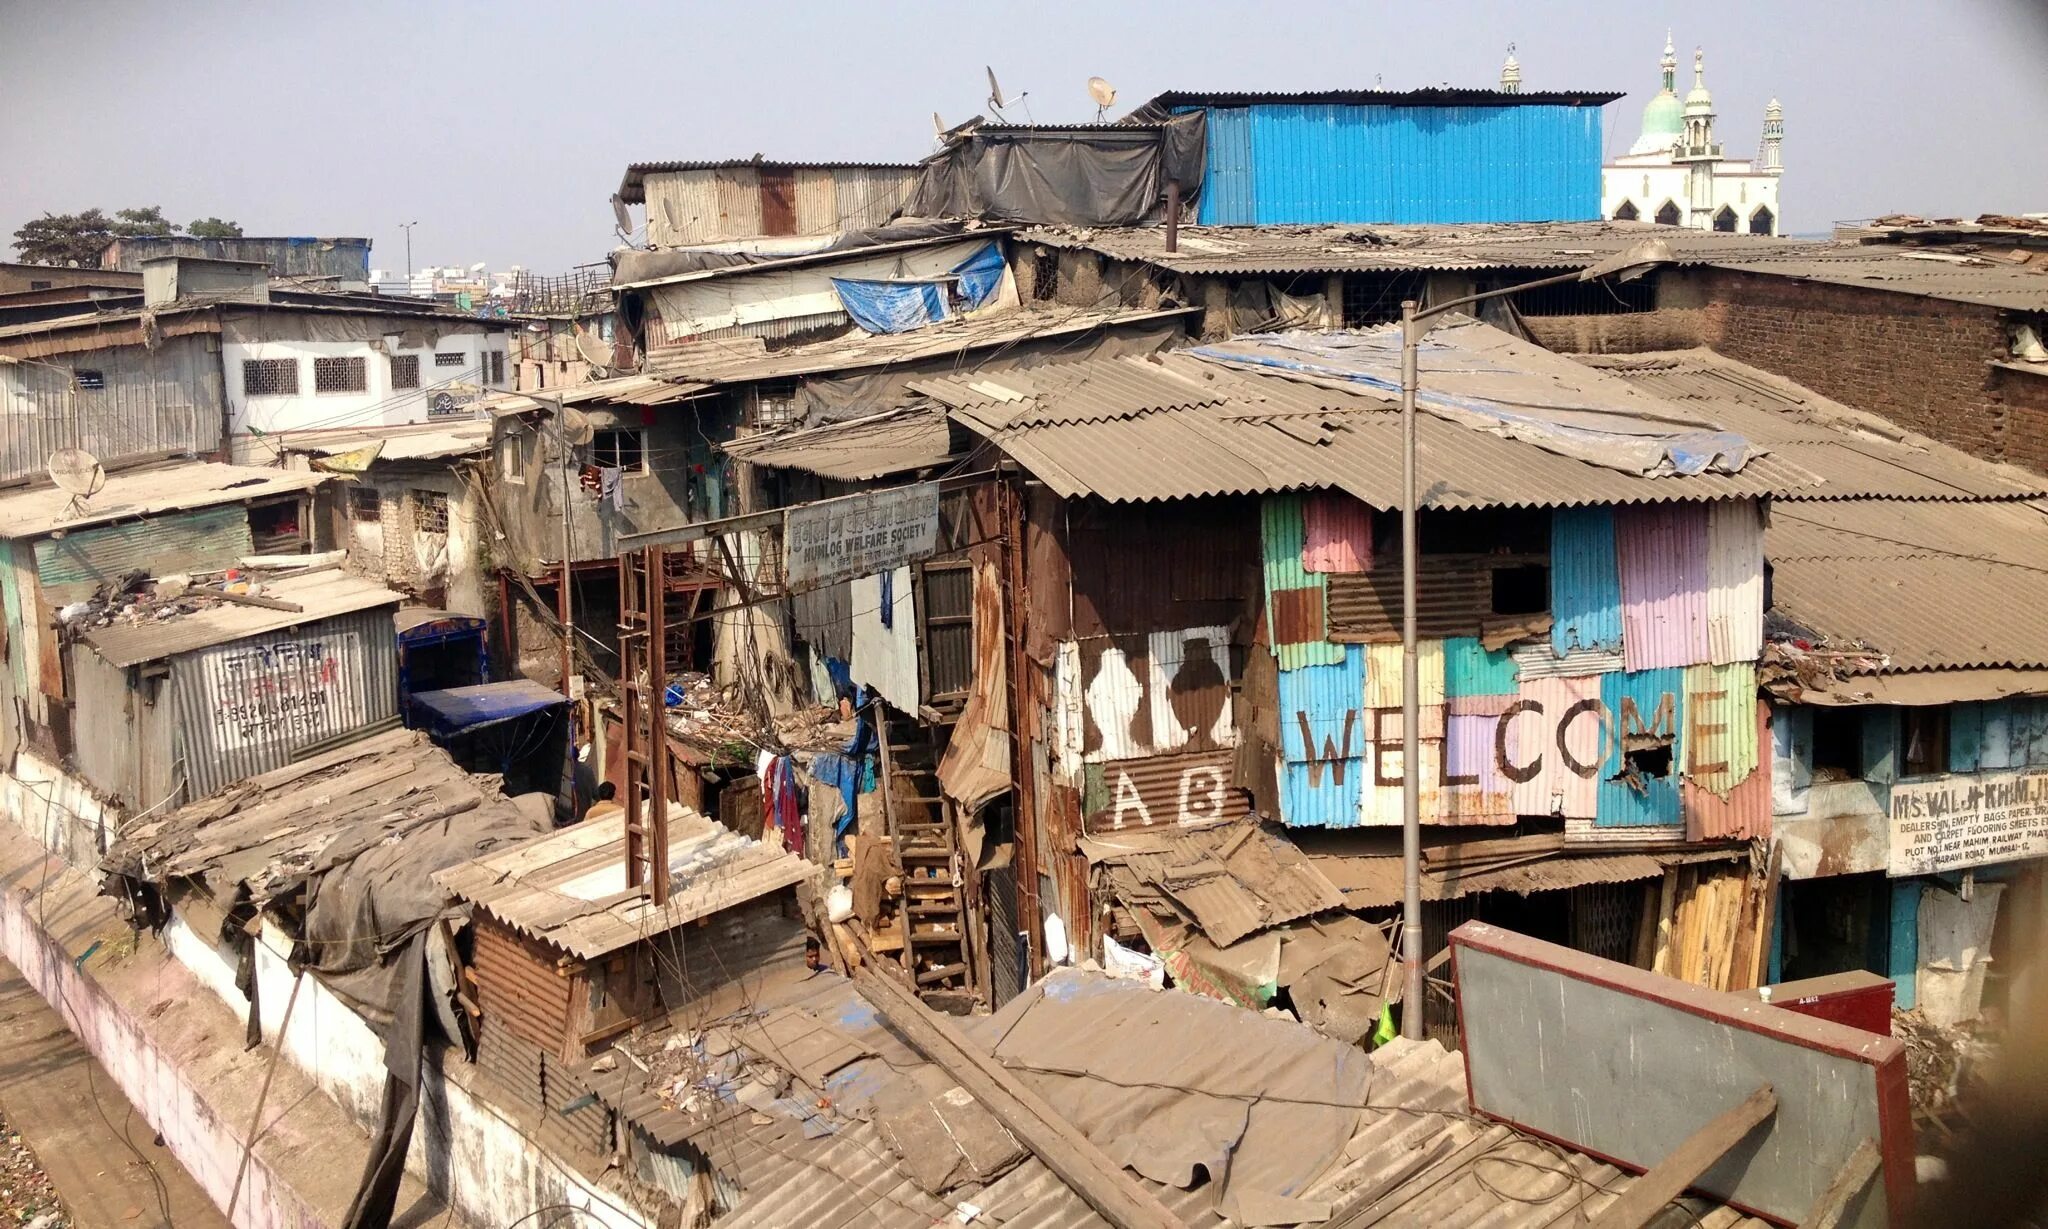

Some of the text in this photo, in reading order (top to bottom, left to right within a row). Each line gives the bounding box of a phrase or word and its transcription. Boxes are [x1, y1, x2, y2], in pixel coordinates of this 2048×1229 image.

[804, 540, 842, 563] HUMLOG
[845, 532, 888, 554] WELFARE
[891, 522, 927, 544] SOCIETY
[1296, 691, 1728, 789] WELCOME
[1113, 765, 1228, 830] A B
[1900, 820, 1937, 833] DEALERS
[1952, 814, 1980, 827] EMPTY
[1984, 811, 2006, 823] BAGS
[1914, 833, 1933, 844] AND
[1935, 828, 1963, 841] CARPET
[1967, 822, 2007, 836] FLOORING
[2009, 817, 2038, 830] SHEETS
[1905, 846, 1924, 857] PLOT
[1992, 832, 2023, 844] RAILWAY
